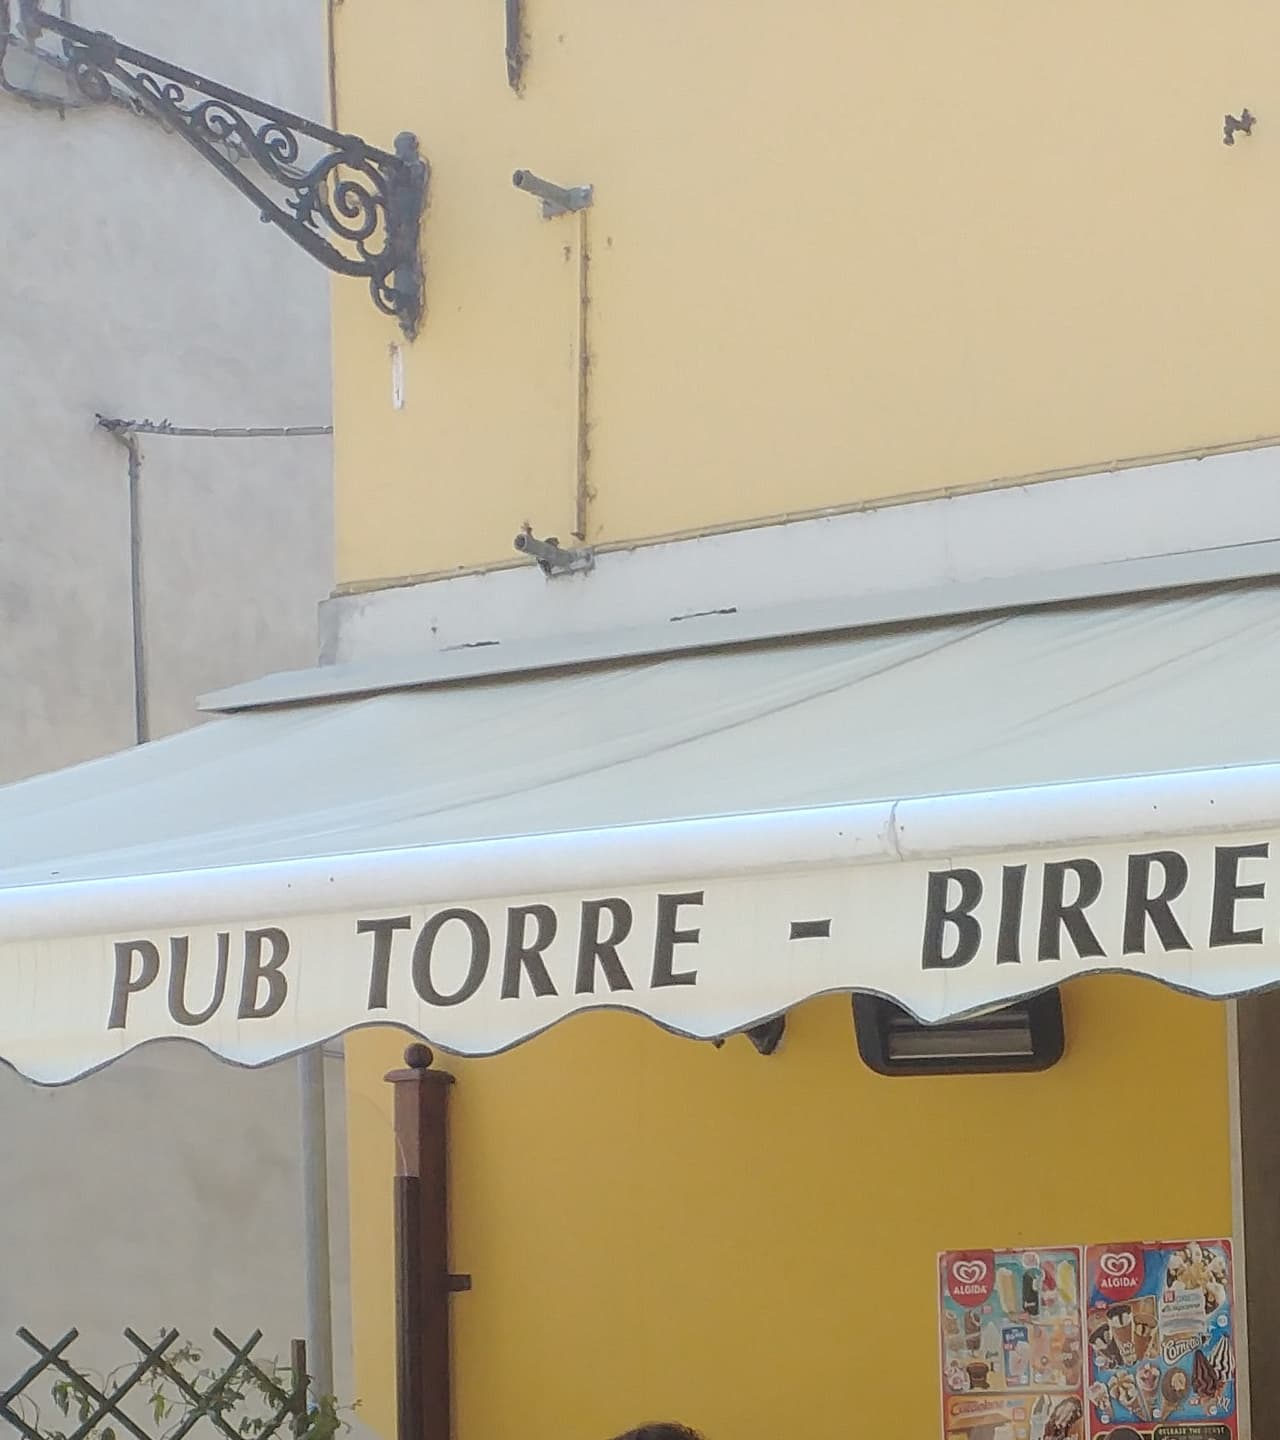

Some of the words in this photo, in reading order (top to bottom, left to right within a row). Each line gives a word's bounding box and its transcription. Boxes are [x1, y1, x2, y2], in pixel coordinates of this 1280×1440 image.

[107, 927, 290, 1030] PUB
[356, 890, 704, 1010] TORRE
[789, 919, 831, 940] -
[1100, 1277, 1138, 1288] ALGIDA
[953, 1284, 988, 1295] ALGIDA
